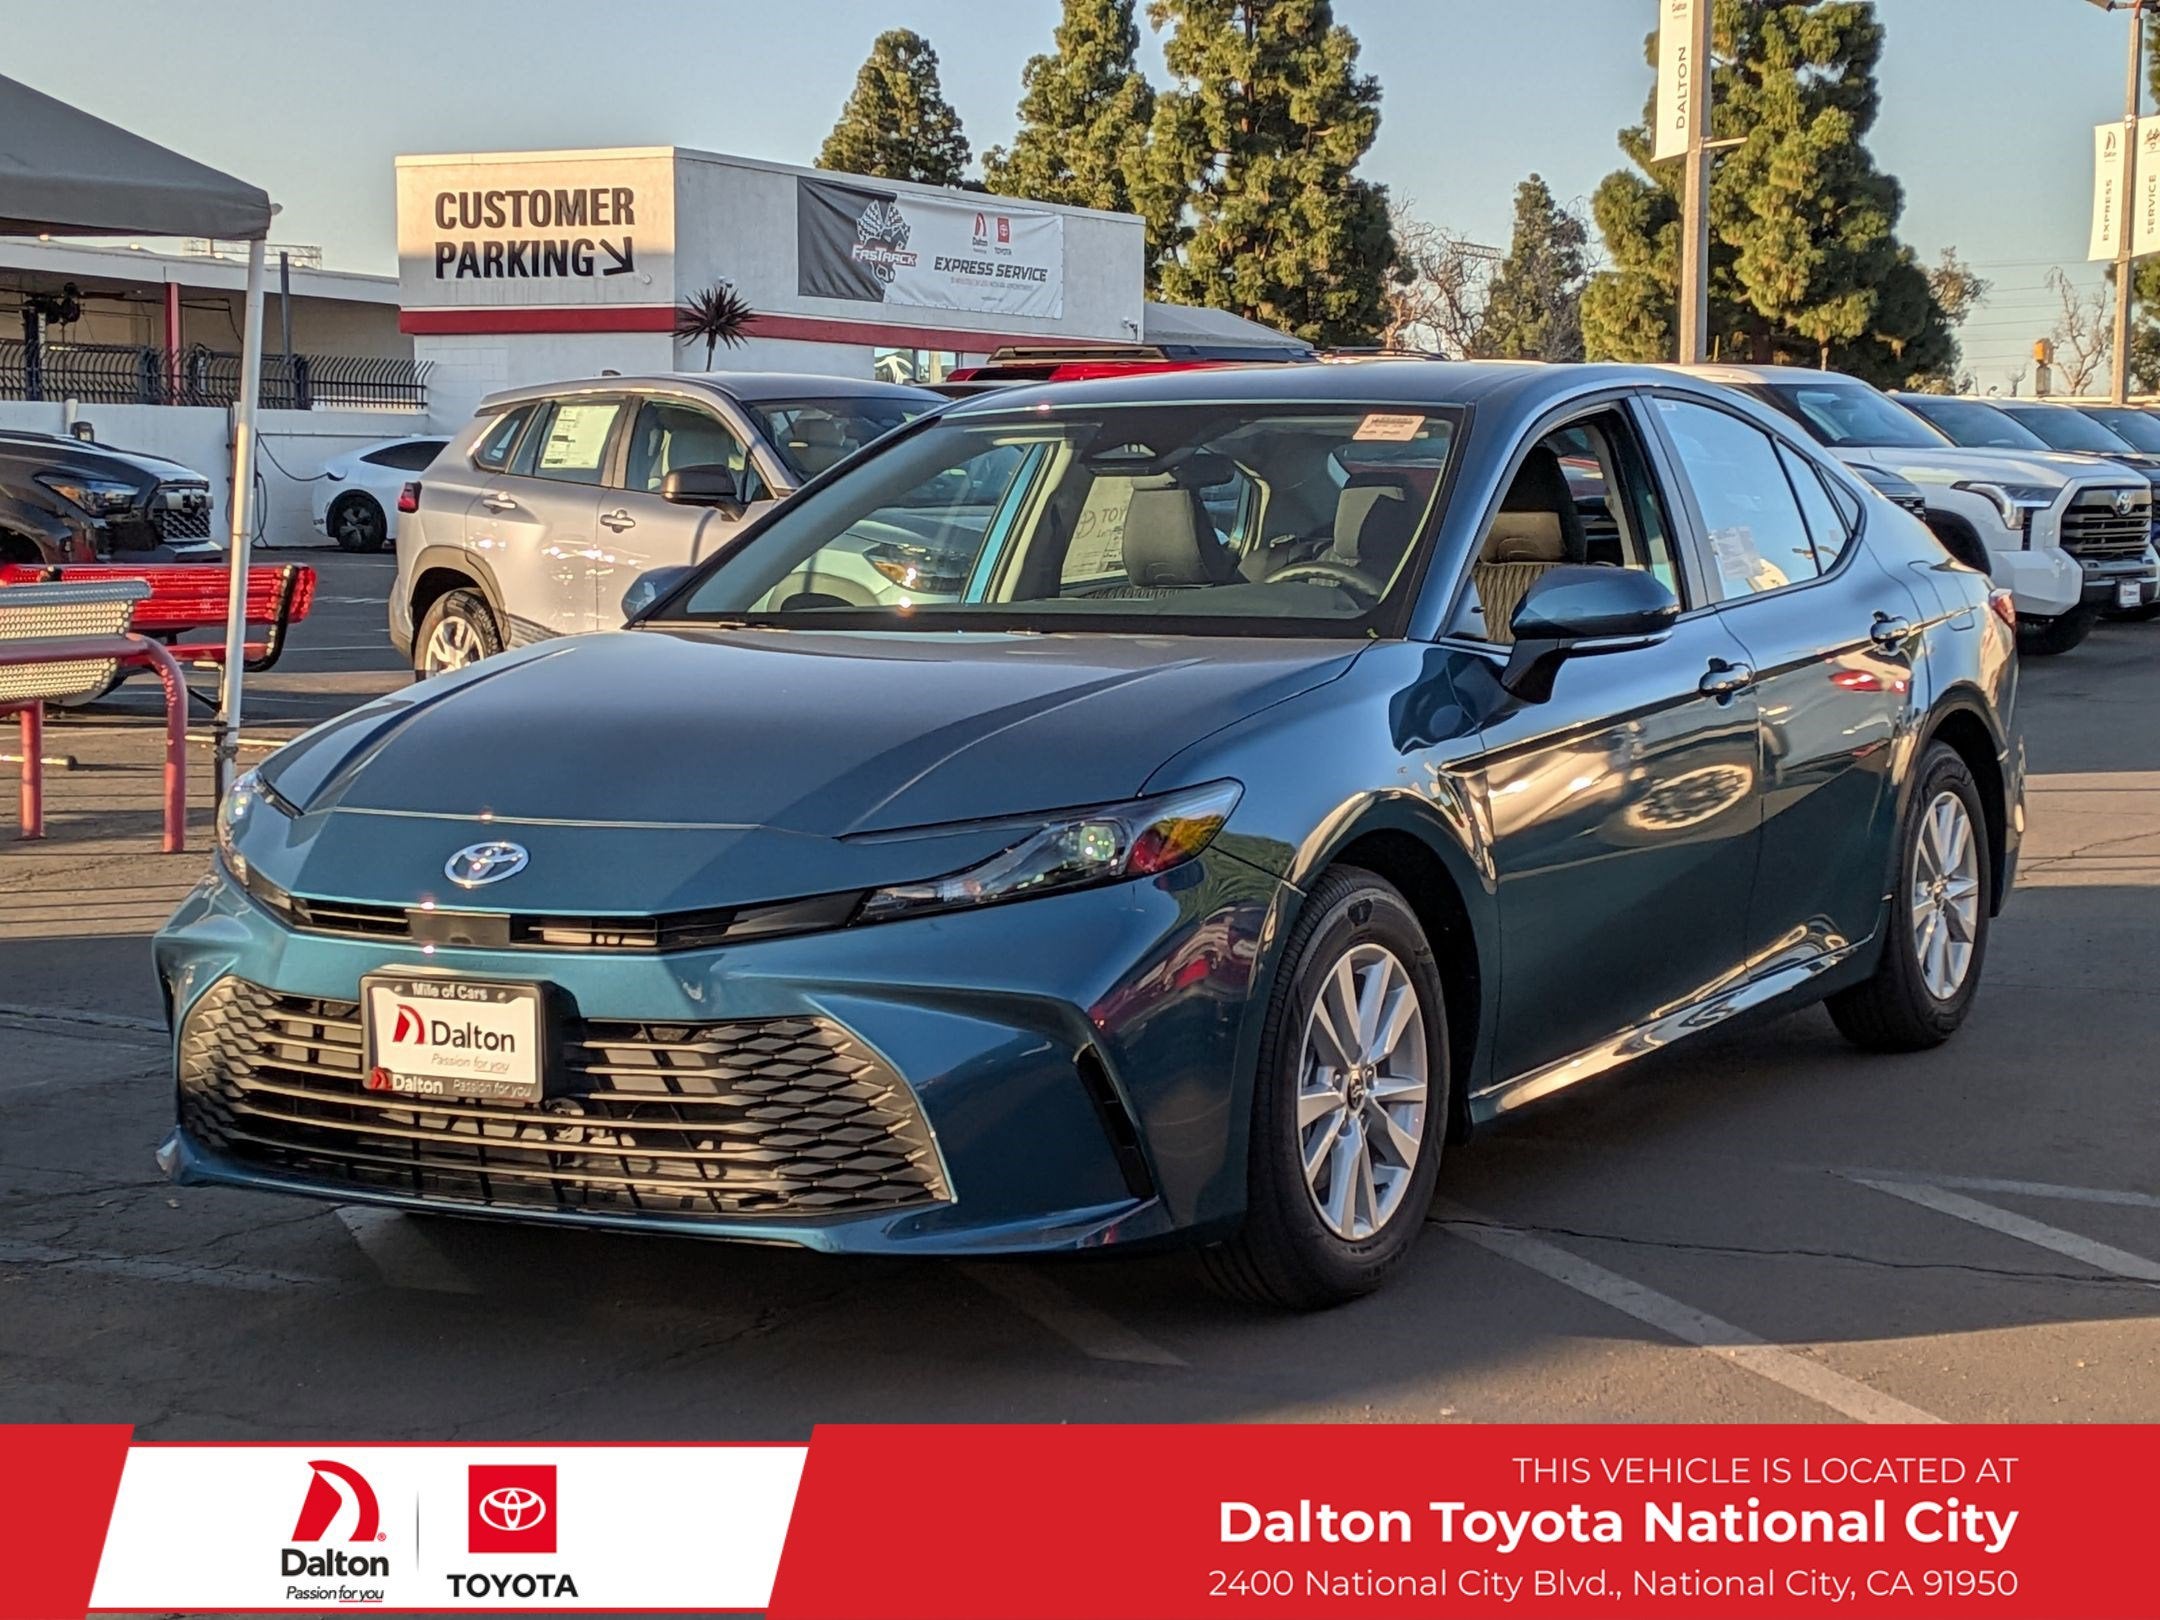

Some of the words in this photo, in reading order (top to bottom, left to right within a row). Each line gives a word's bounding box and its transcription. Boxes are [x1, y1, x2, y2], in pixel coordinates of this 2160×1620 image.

[1676, 46, 1688, 130] DALTON
[435, 187, 635, 229] CUSTOMER
[2102, 179, 2112, 241] EXPRESS
[2147, 174, 2157, 235] SERVICE
[435, 238, 595, 279] PARKING
[934, 256, 994, 276] EXPRESS
[995, 264, 1048, 282] SERVICE
[412, 983, 439, 998] Mile
[441, 985, 455, 999] of
[457, 986, 488, 1000] Cars
[431, 1020, 516, 1053] Dalton
[431, 1053, 470, 1067] Passion
[473, 1056, 488, 1070] for
[489, 1060, 511, 1073] you
[392, 1074, 444, 1095] Dalton
[453, 1079, 491, 1094] Passion
[493, 1082, 510, 1096] for
[511, 1085, 532, 1098] you
